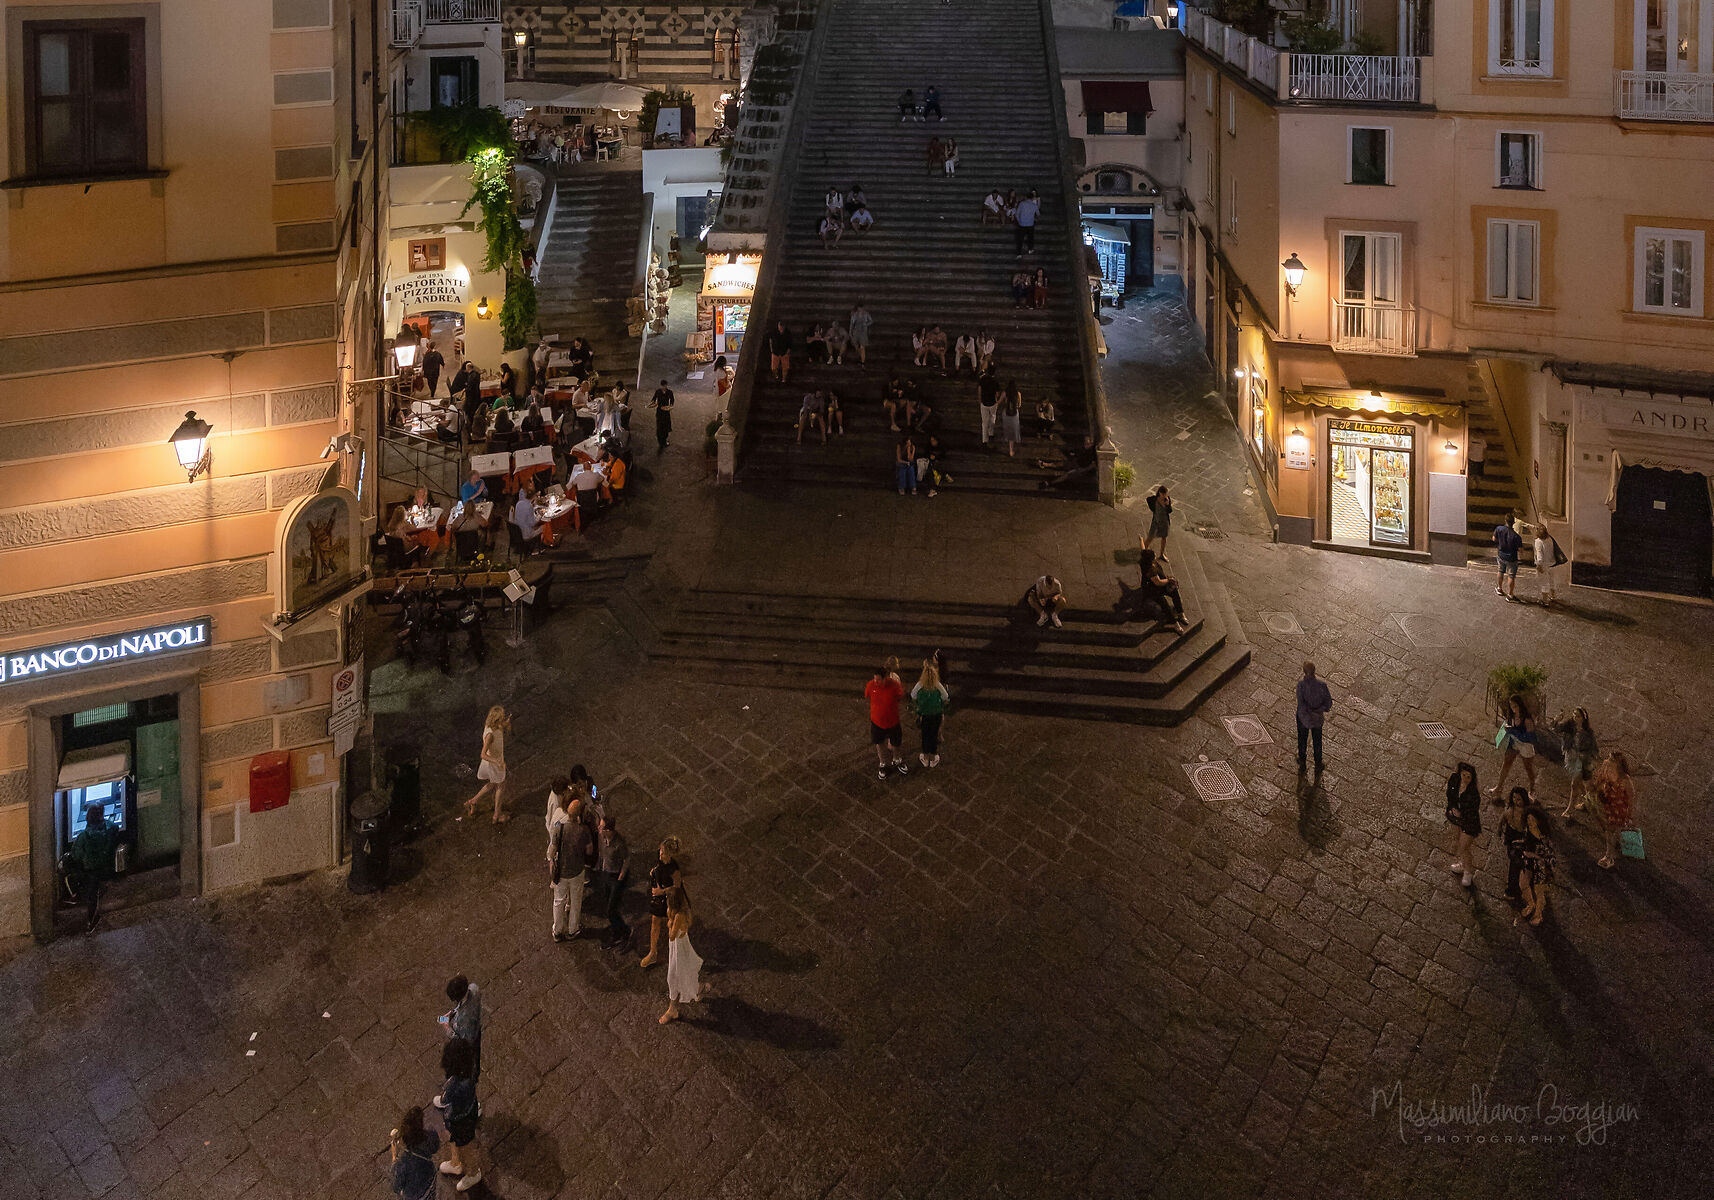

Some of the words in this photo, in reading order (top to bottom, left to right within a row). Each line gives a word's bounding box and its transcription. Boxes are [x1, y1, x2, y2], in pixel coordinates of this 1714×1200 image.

[545, 105, 596, 115] RISTORANTE
[394, 278, 466, 294] RISTORANTE
[707, 281, 754, 291] SANDWICHES
[404, 287, 457, 299] PIZZERIA
[414, 294, 462, 305] ANDREA
[1340, 421, 1351, 430] Il
[1354, 422, 1405, 435] Limoncello
[10, 643, 98, 677] BANCO
[99, 644, 119, 661] DI
[120, 624, 206, 657] NAPOLI
